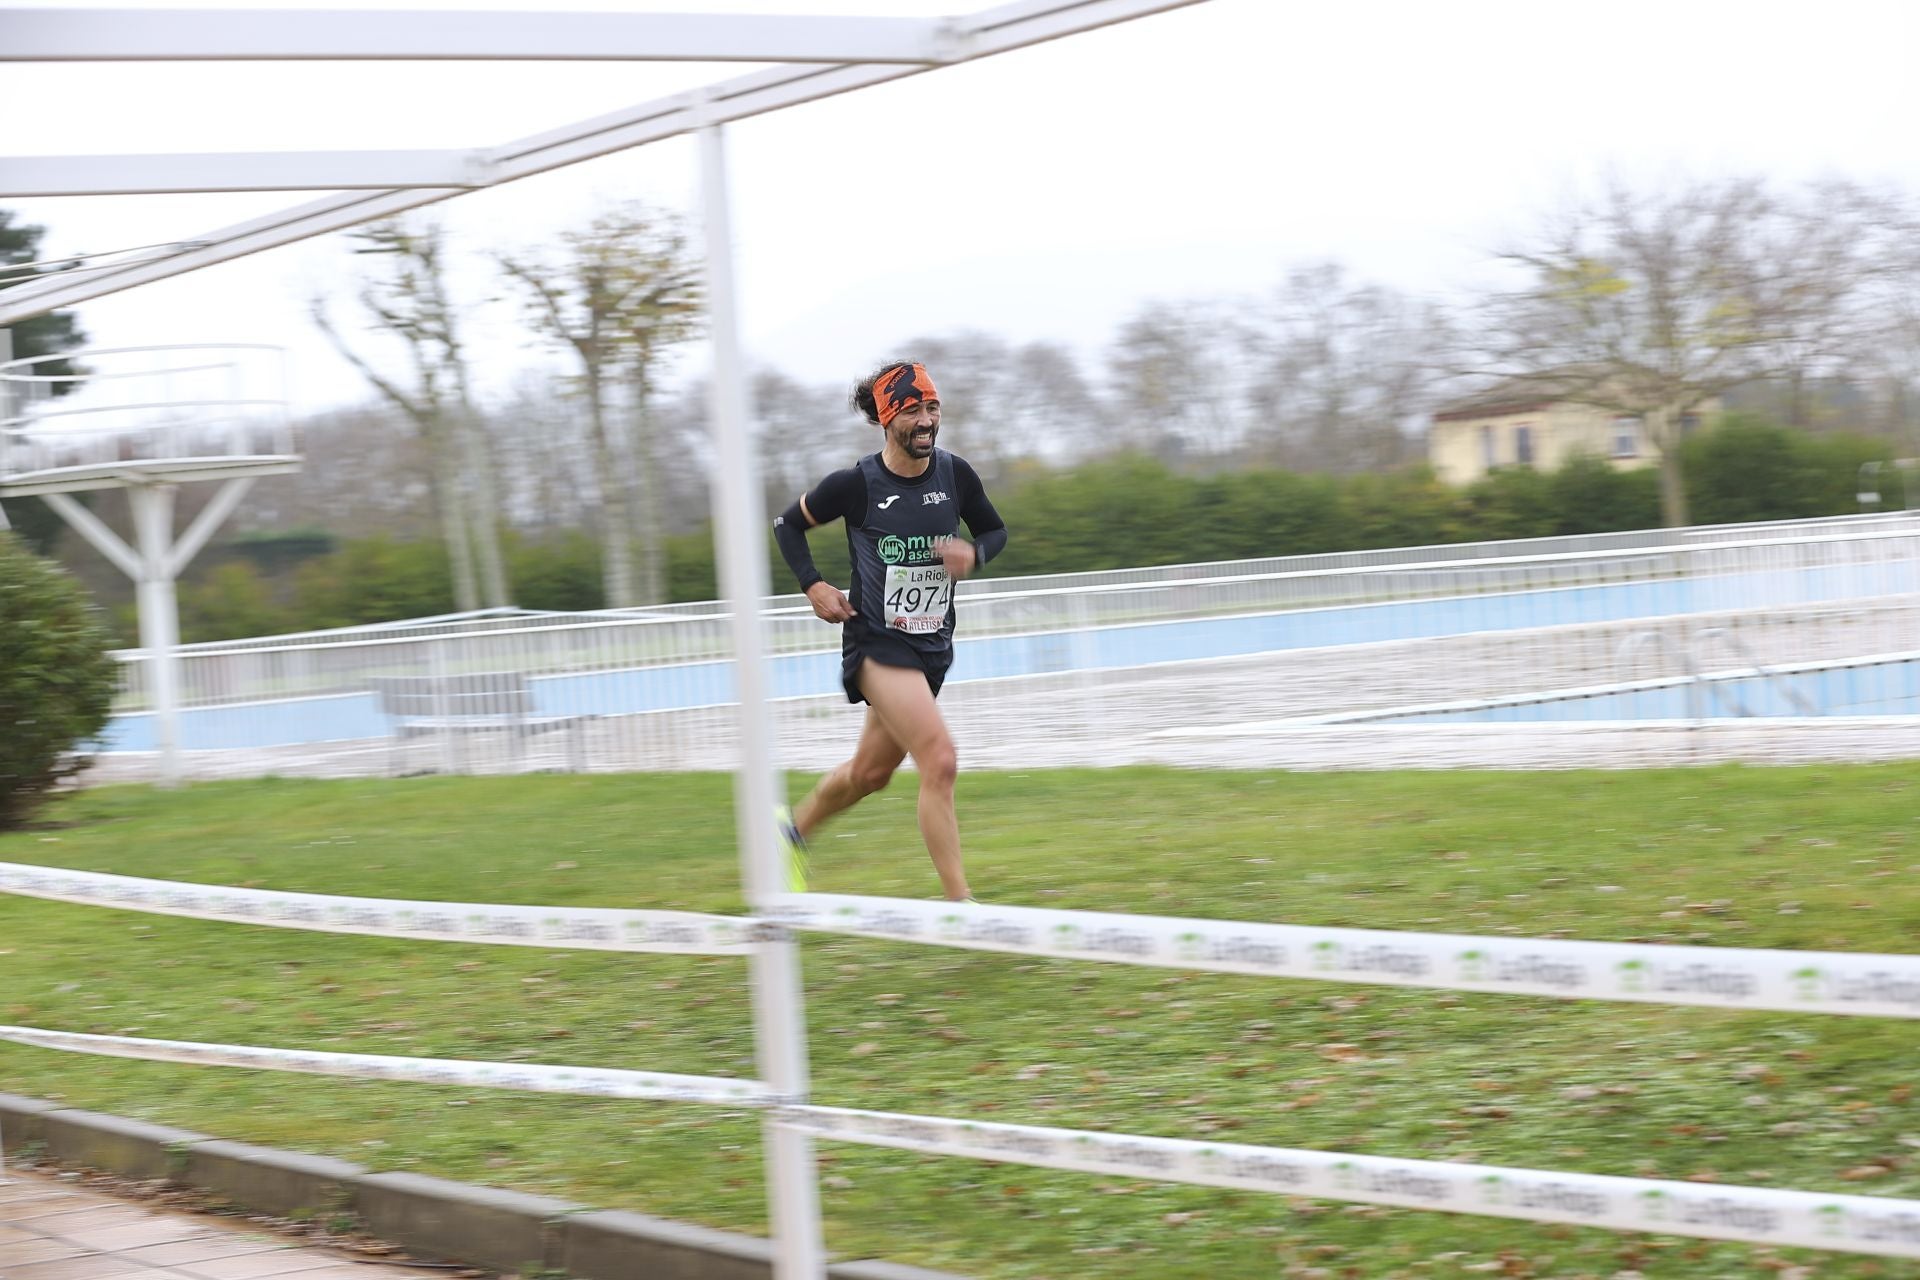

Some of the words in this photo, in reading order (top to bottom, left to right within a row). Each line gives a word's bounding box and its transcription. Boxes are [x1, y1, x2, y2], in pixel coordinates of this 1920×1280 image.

[911, 571, 923, 582] La
[925, 568, 949, 582] Rioja
[887, 583, 950, 613] 4974
